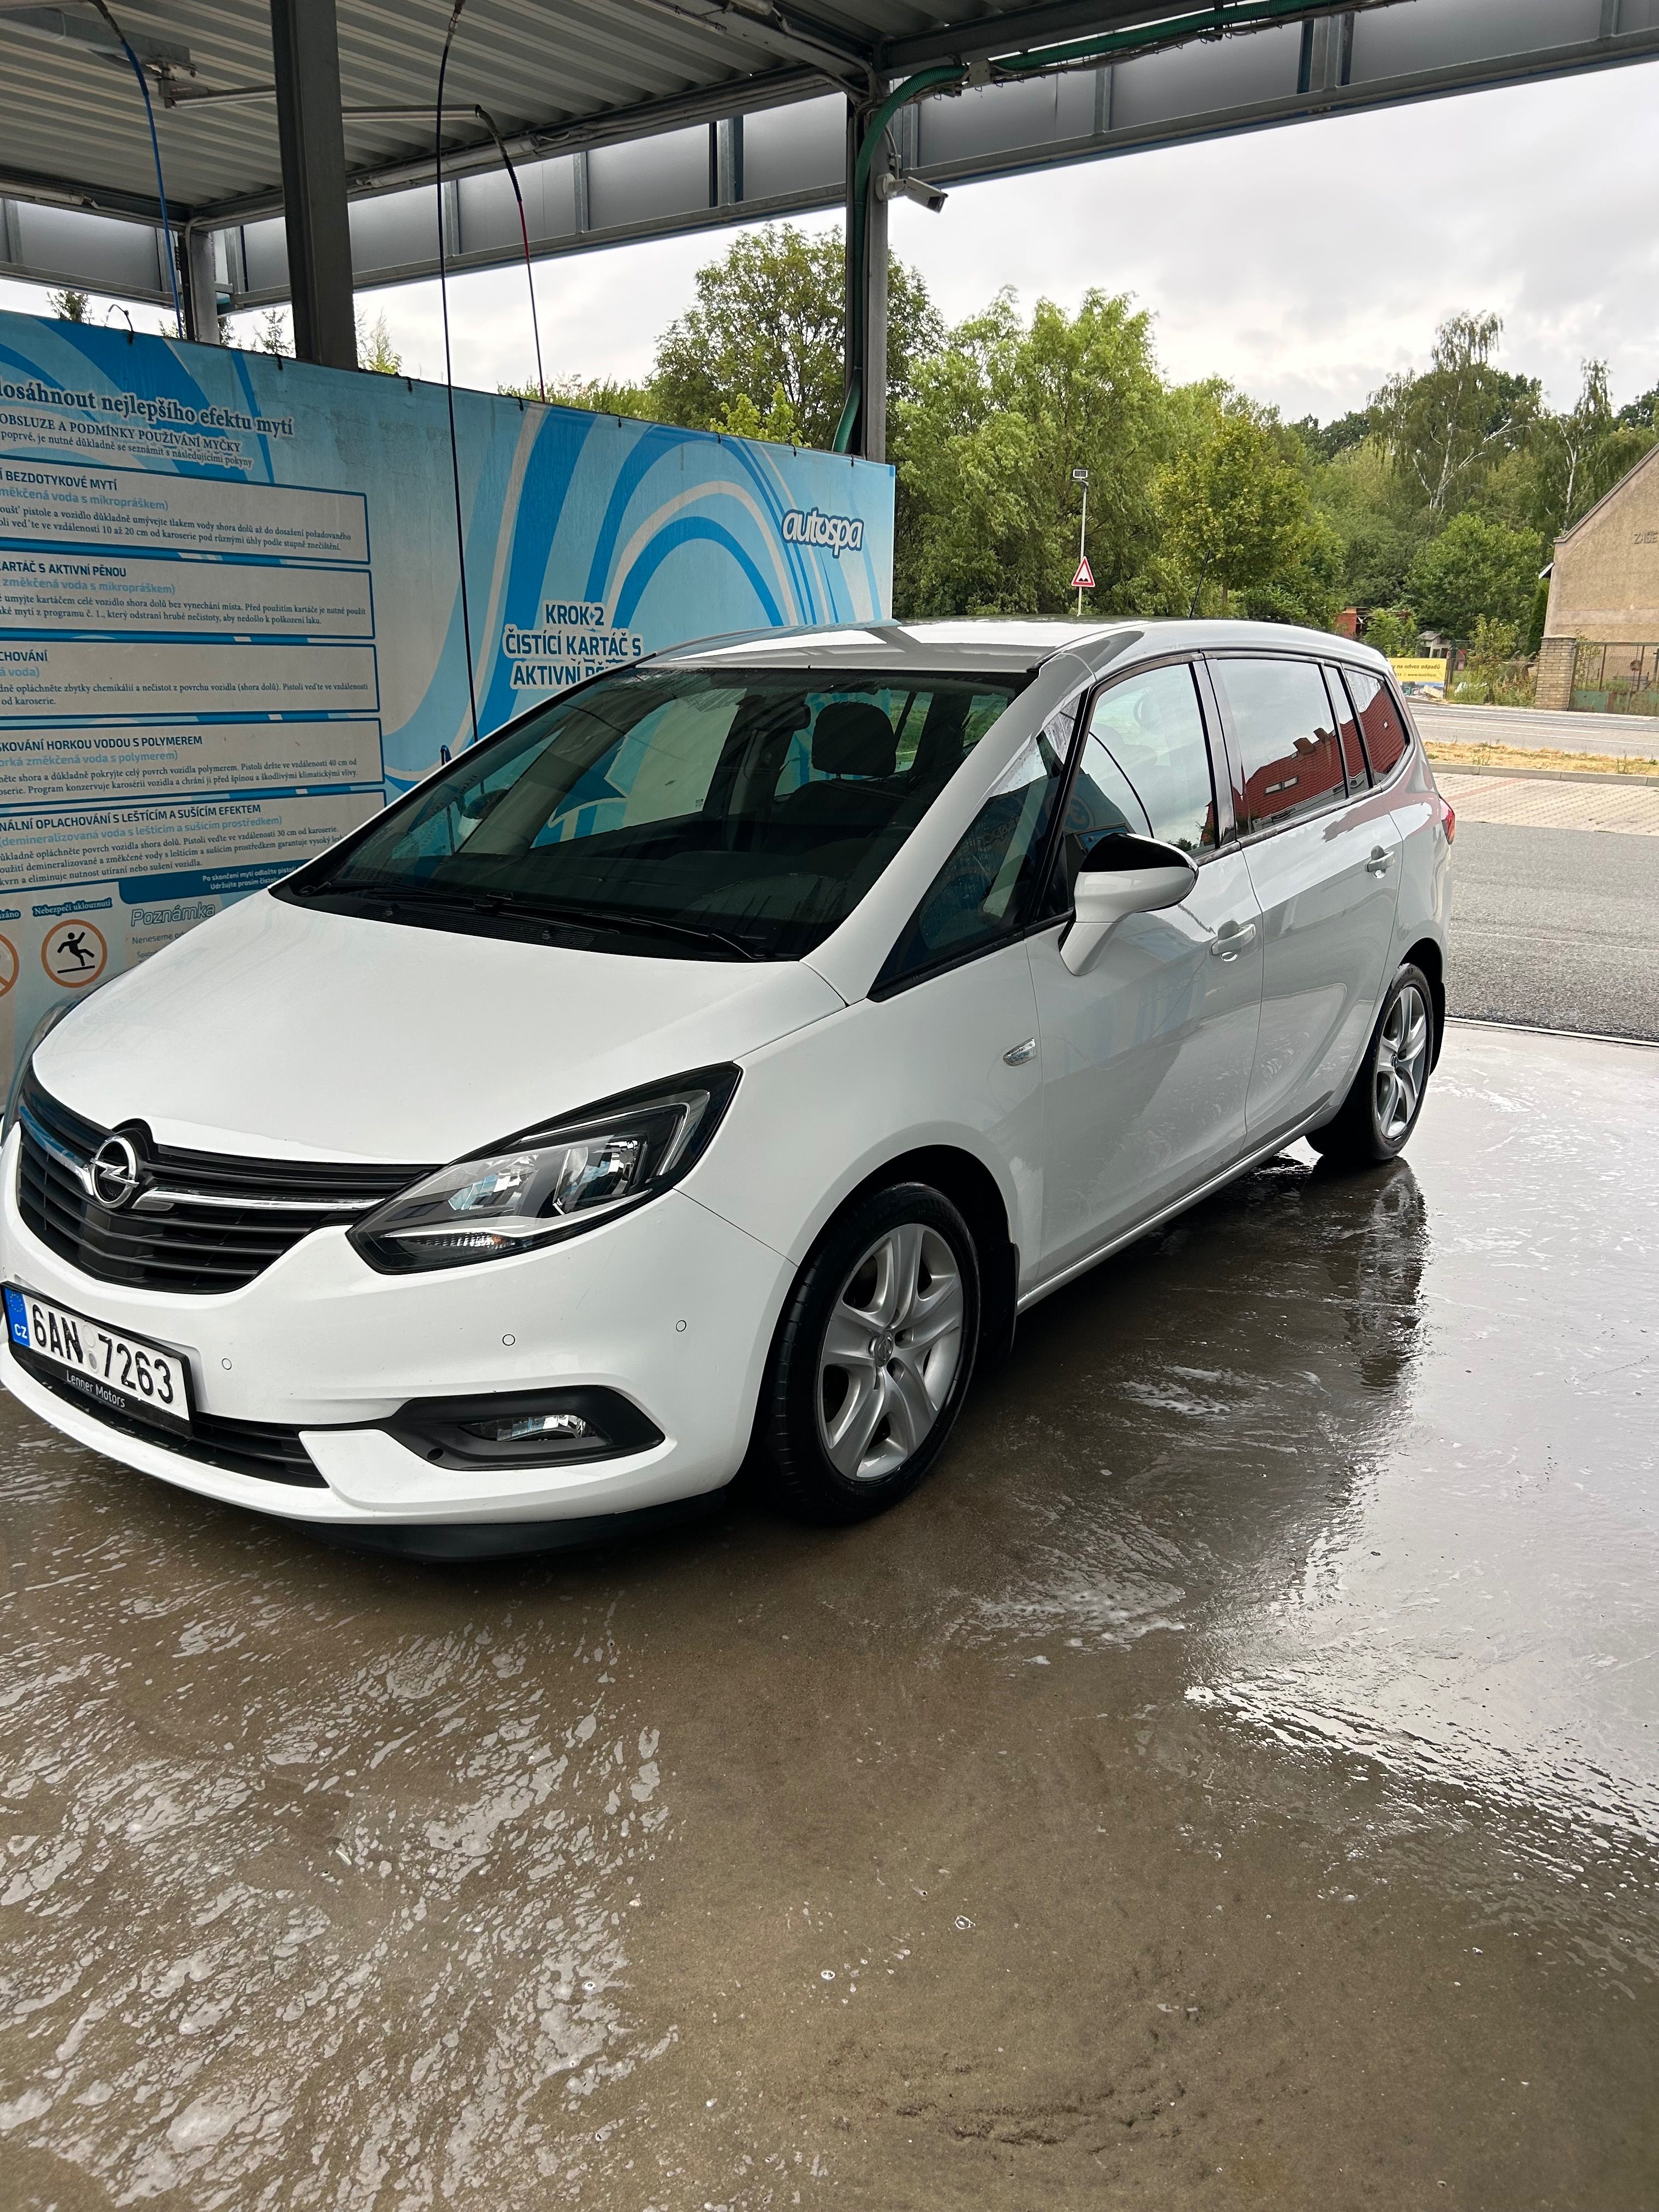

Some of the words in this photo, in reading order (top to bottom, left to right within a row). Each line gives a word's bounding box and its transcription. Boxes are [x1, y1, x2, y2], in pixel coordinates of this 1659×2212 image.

[101, 395, 195, 421] nejlepšího
[201, 408, 252, 429] efektu
[256, 419, 294, 437] mytí
[0, 414, 54, 429] OBSLUZE
[58, 421, 67, 431] A
[70, 422, 134, 438] PODMÍNKY
[138, 429, 200, 447] POUŽÍVÁNÍ
[204, 438, 241, 452] MYČKY
[38, 435, 46, 444] je
[49, 436, 73, 445] nutné
[76, 437, 115, 450] důkladně
[128, 444, 164, 455] seznámit
[225, 456, 252, 468] pokyny
[6, 471, 87, 488] BEZDOTYKOVÉ
[91, 478, 117, 491] MYTÍ
[52, 492, 78, 503] voda
[90, 495, 168, 511] mikropráškem)
[23, 508, 52, 518] pistole
[61, 510, 91, 520] vozidlo
[93, 512, 131, 523] důkladně
[133, 516, 167, 527] umývejte
[170, 518, 194, 528] tlakem
[197, 522, 215, 531] vody
[216, 522, 236, 531] shora
[238, 524, 253, 533] dolů
[264, 526, 273, 534] do
[150, 529, 160, 537] od
[162, 529, 196, 540] karoserie
[199, 533, 212, 543] pod
[782, 508, 864, 557] autospa
[49, 563, 90, 575] AKTIVNÍ
[93, 565, 126, 577] PĚNOU
[3, 578, 59, 589] změkčená
[61, 580, 87, 590] voda
[4, 596, 34, 605] umyjte
[95, 598, 125, 606] vozidlo
[127, 599, 148, 607] shora
[150, 599, 166, 607] dolů
[223, 614, 235, 623] aby
[545, 604, 590, 625] KROK
[595, 607, 604, 625] 2
[506, 628, 561, 654] ČISTÍCÍ
[567, 632, 628, 656] KARTÁČ
[633, 637, 641, 656] S
[8, 666, 40, 678] voda)
[514, 661, 581, 685] AKTIVNÍ
[17, 684, 61, 695] opláchněte
[64, 684, 90, 694] zbytky
[180, 683, 208, 693] povrchu
[47, 740, 91, 751] HORKOU
[94, 738, 130, 748] VODOU
[142, 736, 202, 746] POLYMEREM
[27, 754, 81, 766] změkčená
[83, 753, 108, 763] voda
[119, 750, 178, 764] polymerem)
[19, 774, 41, 782] shora
[51, 771, 88, 780] důkladně
[125, 769, 140, 777] celý
[143, 767, 167, 777] povrch
[170, 766, 196, 774] vozidla
[29, 786, 63, 795] Program
[66, 783, 110, 792] konzervuje
[148, 778, 173, 787] vozidla
[36, 814, 111, 829] OPLACHOVÁNÍ
[122, 809, 167, 822] LEŠTÍCÍM
[178, 805, 216, 818] SUŠÍCÍM
[219, 804, 261, 815] EFEKTEM
[101, 828, 126, 838] voda
[83, 844, 109, 856] povrch
[112, 842, 138, 851] vozidla
[145, 851, 163, 860] vody
[35, 904, 71, 915] Nebezpečí
[131, 902, 216, 927] Poznámka
[132, 933, 172, 944] Neneseme
[14, 1323, 27, 1339] CZ
[32, 1304, 83, 1364] 6AN
[98, 1332, 174, 1404] 7263
[66, 1369, 93, 1393] Lenner
[96, 1384, 125, 1408] Motors
